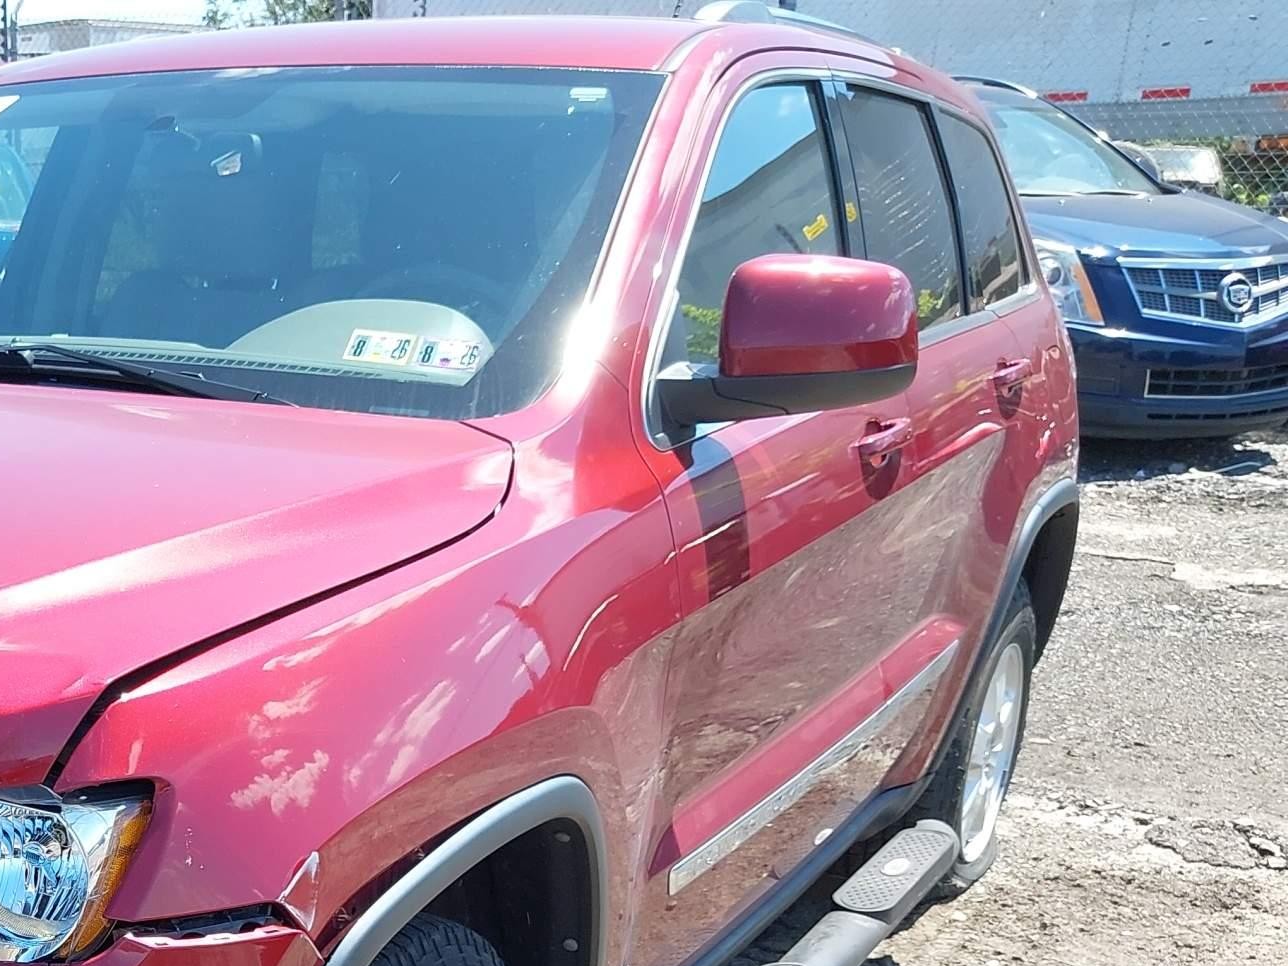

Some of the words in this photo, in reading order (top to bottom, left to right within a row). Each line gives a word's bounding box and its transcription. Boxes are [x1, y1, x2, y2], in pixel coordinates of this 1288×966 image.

[353, 339, 367, 357] 8
[390, 338, 411, 361] 26
[420, 345, 434, 364] 8
[459, 344, 479, 366] 26
